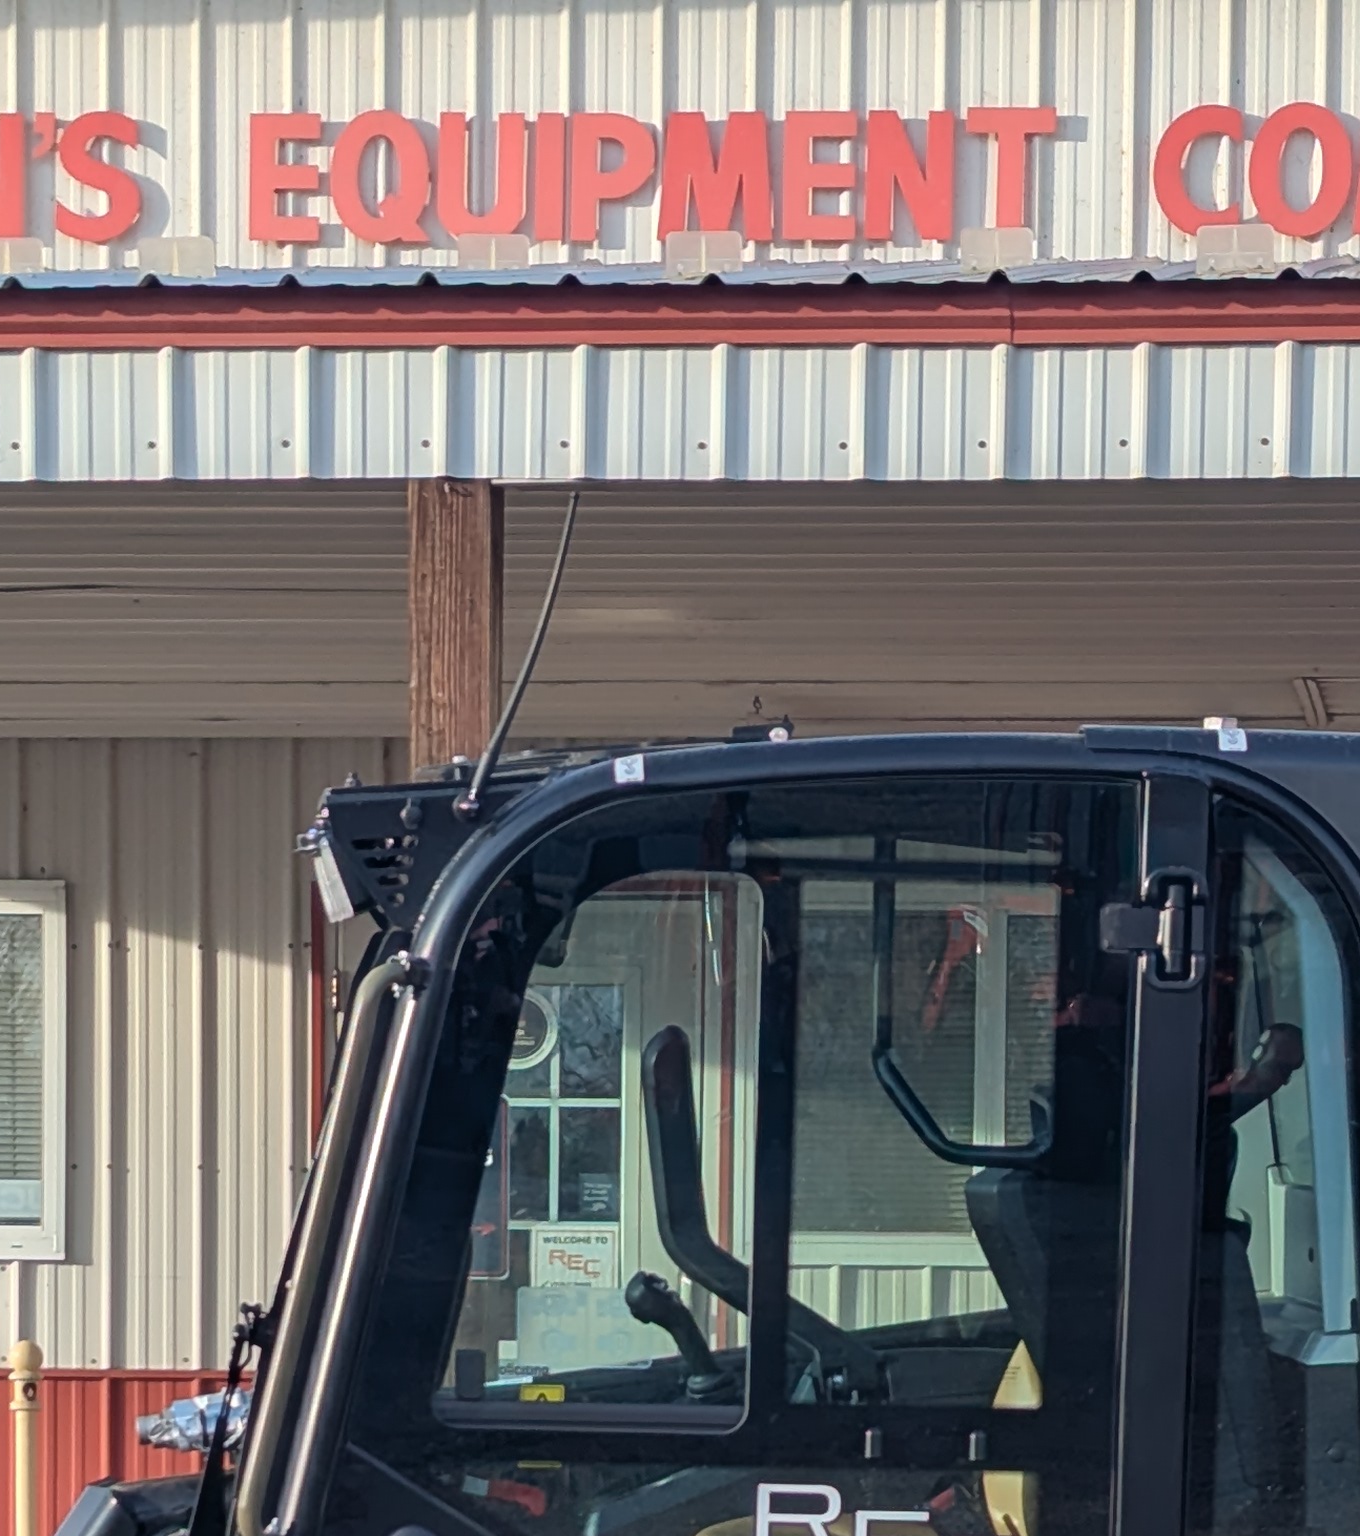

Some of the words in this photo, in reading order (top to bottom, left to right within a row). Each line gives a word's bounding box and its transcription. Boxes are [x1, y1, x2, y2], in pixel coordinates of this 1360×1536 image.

[248, 107, 1057, 245] EQUIPMENT
[543, 1236, 592, 1245] WELCOME
[595, 1236, 609, 1245] TO
[548, 1249, 601, 1277] REC
